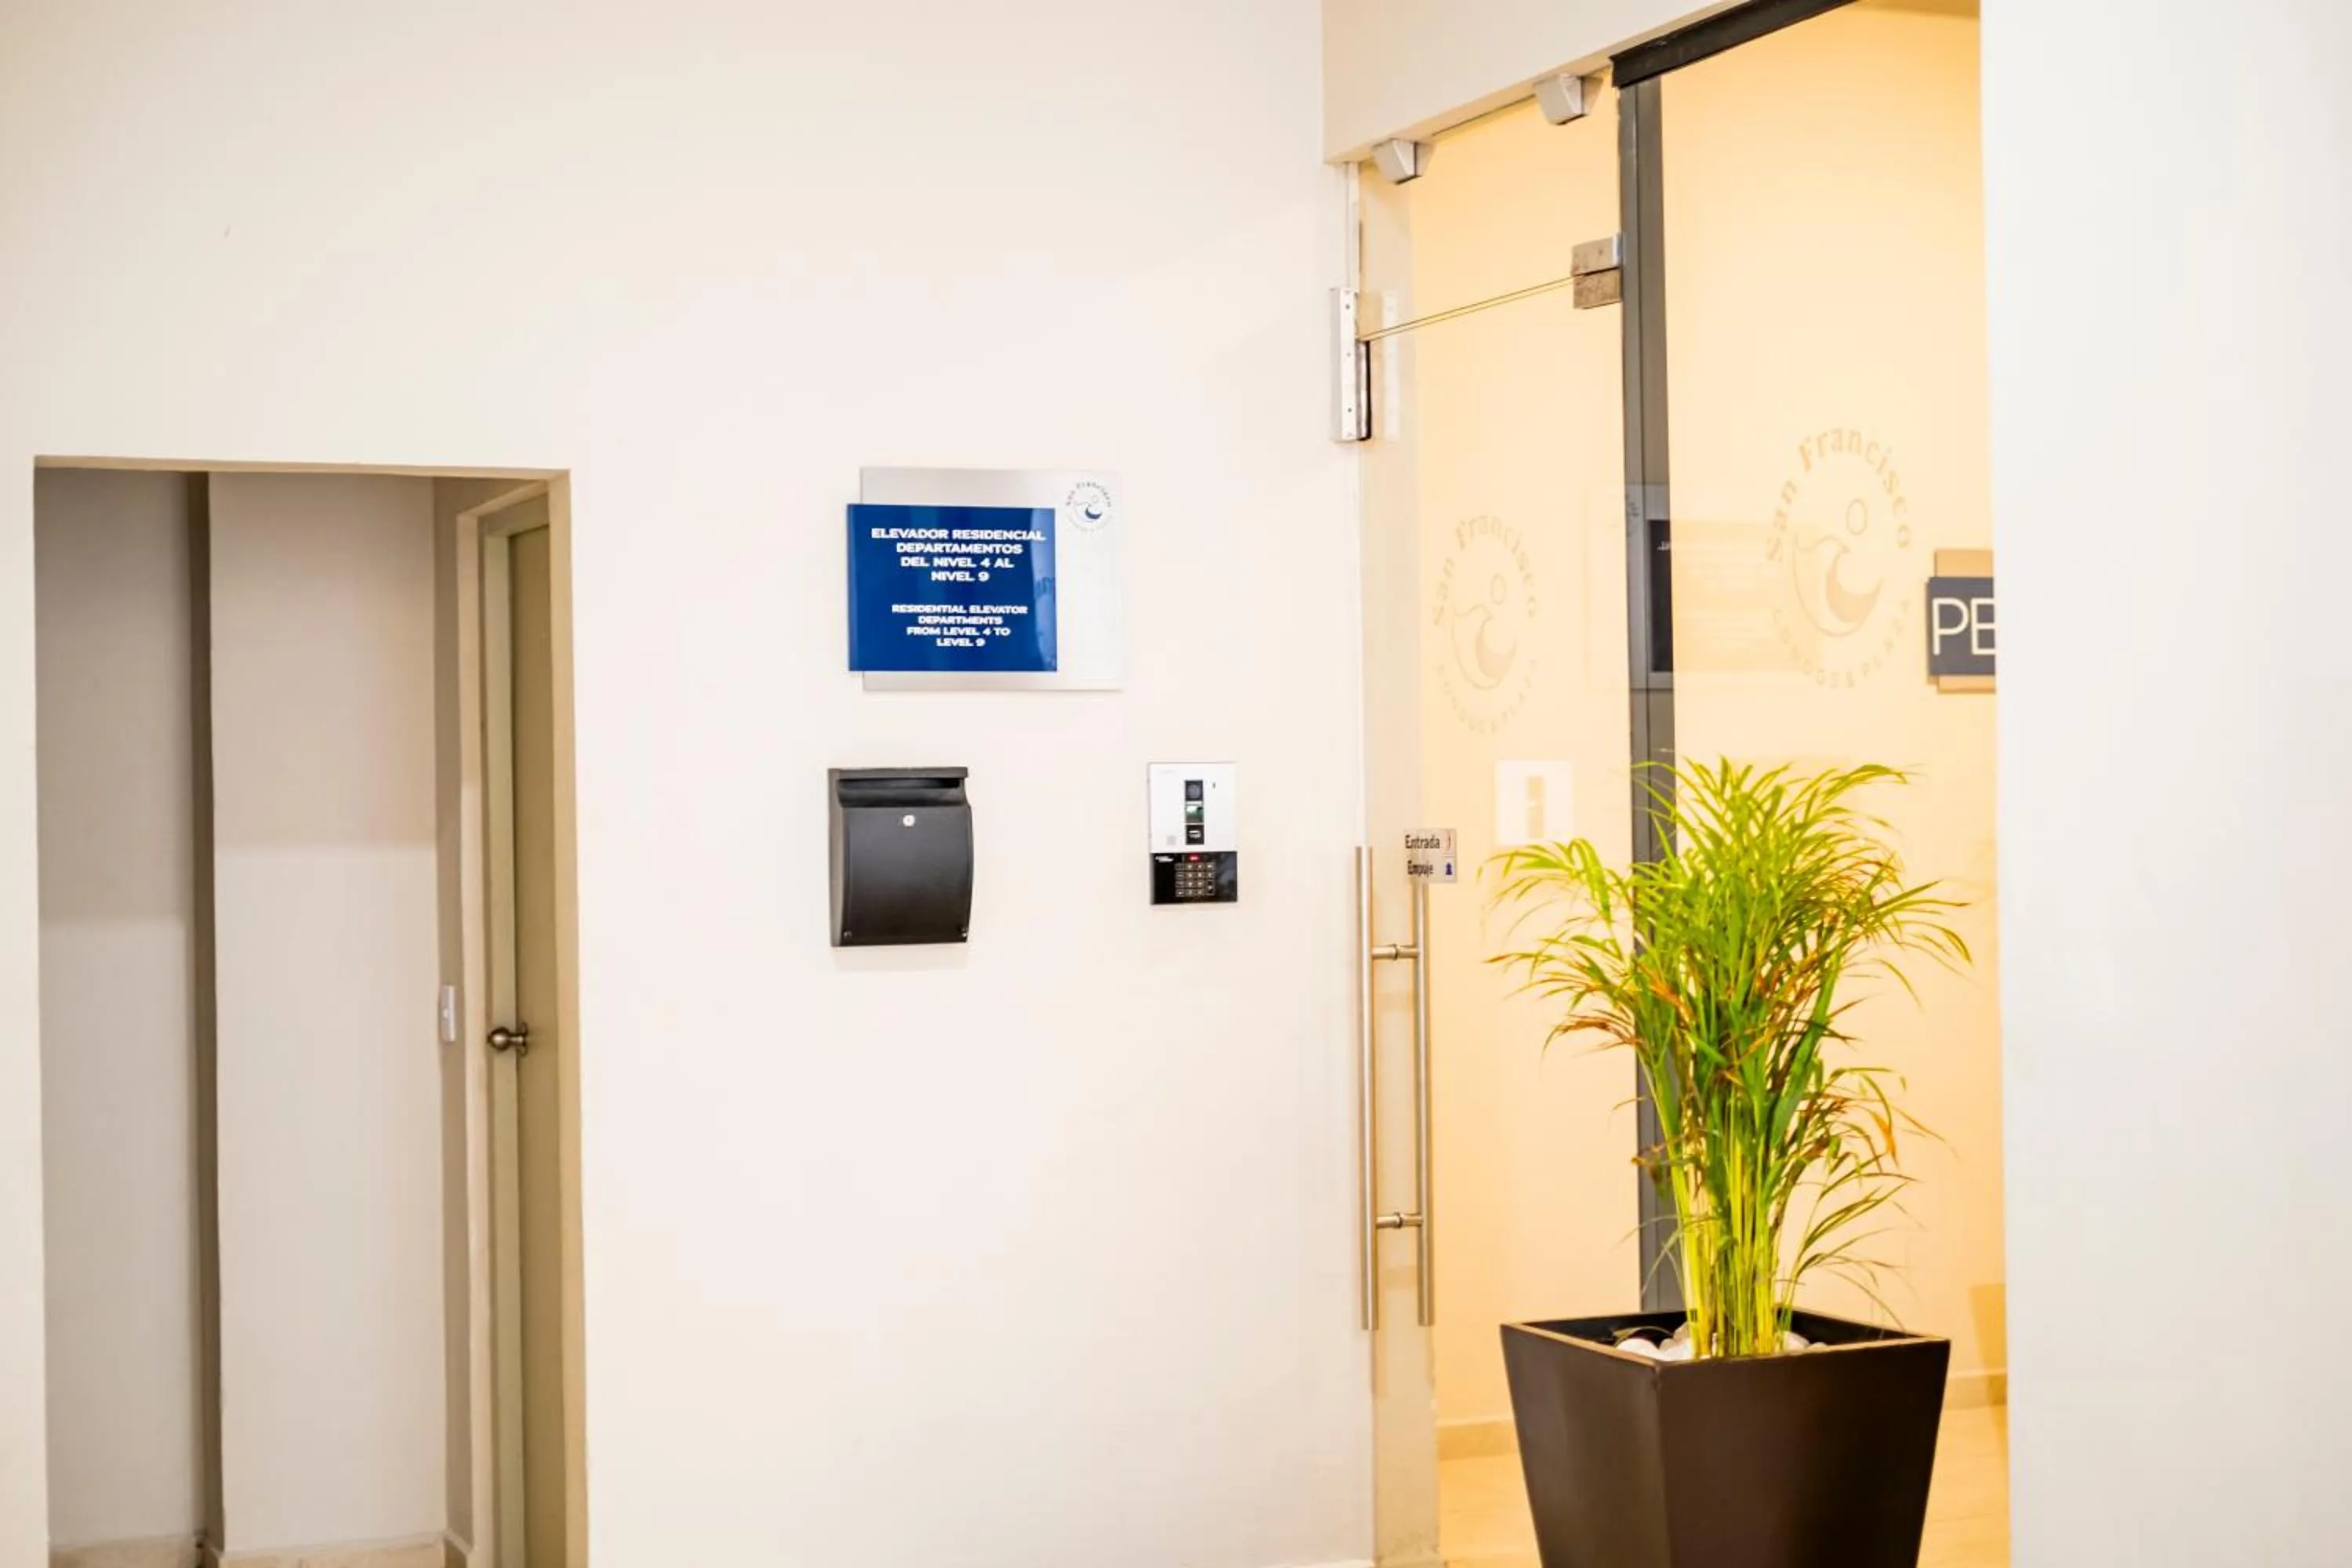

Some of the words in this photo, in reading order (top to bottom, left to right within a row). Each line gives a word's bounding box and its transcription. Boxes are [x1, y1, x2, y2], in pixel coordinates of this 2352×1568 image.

[1798, 427, 1911, 550] Francisco
[871, 528, 949, 540] ELEVADOR
[952, 529, 1047, 541] RESIDENCIAL
[896, 542, 1022, 554] DEPARTAMENTOS
[900, 556, 930, 568] DEL
[934, 557, 977, 568] NIVEL
[980, 557, 991, 568] 4
[994, 557, 1014, 568] AL
[931, 571, 975, 583] NIVEL
[978, 572, 990, 583] 9
[891, 604, 967, 615] RESIDENTIAL
[969, 604, 1029, 615] ELEVATOR
[917, 615, 1004, 625] DEPARTMENTS
[906, 626, 941, 636] FROM
[943, 626, 980, 637] LEVEL
[982, 627, 991, 637] 4
[993, 627, 1011, 637] TO
[936, 637, 974, 647] LEVEL
[976, 638, 985, 647] 9
[1405, 834, 1440, 848] Entrada
